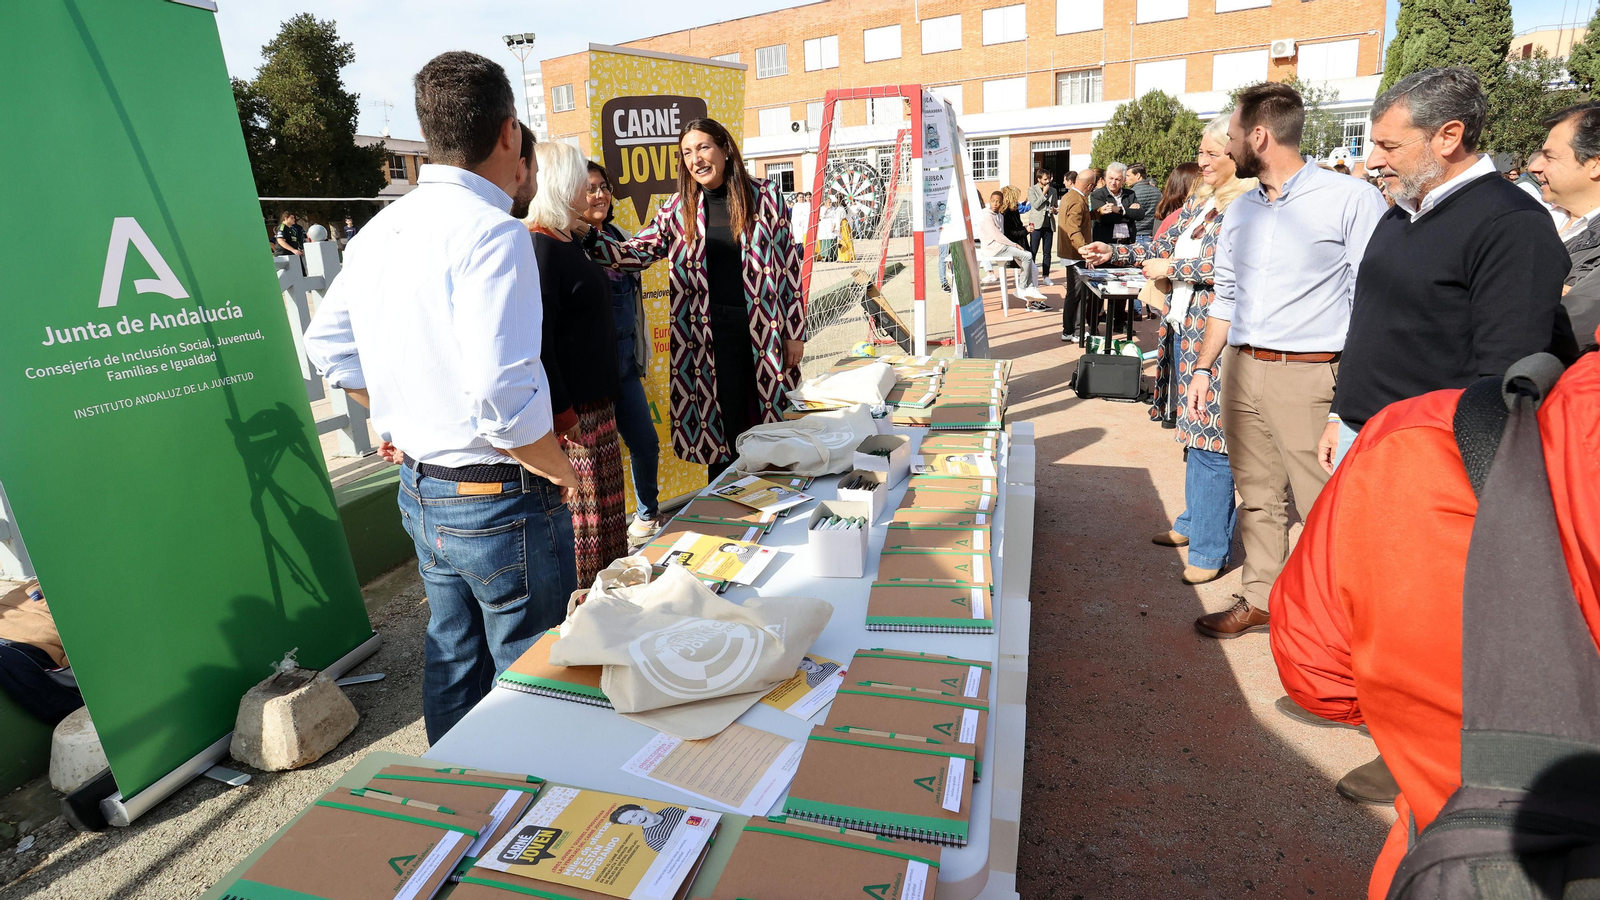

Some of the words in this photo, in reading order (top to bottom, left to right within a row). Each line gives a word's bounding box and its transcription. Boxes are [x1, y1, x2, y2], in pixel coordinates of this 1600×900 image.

[613, 103, 681, 138] CARNÉ
[618, 144, 680, 184] JOVE
[42, 320, 112, 347] Junta
[116, 314, 144, 336] de
[150, 300, 243, 331] Andalucía
[25, 356, 101, 380] Consejería
[104, 353, 120, 366] de
[122, 343, 178, 364] Inclusión
[179, 337, 215, 354] Social,
[216, 329, 265, 347] Juventud,
[107, 361, 158, 382] Familias
[160, 362, 168, 372] e
[170, 352, 217, 372] Igualdad
[74, 398, 133, 420] INSTITUTO
[135, 387, 182, 406] ANDALUZ
[184, 385, 196, 395] DE
[198, 382, 209, 392] LA
[210, 371, 254, 390] JUVENTUD
[503, 834, 531, 860] CARNÉ
[520, 830, 556, 863] JOVEN
[563, 857, 583, 876] Miles
[581, 846, 591, 856] de
[590, 822, 612, 845] ofertas
[572, 868, 585, 877] TE
[581, 845, 604, 867] ESTÁN
[582, 837, 620, 880] ESPERANDO
[394, 876, 407, 892] Junta
[412, 843, 434, 868] Andalucía
